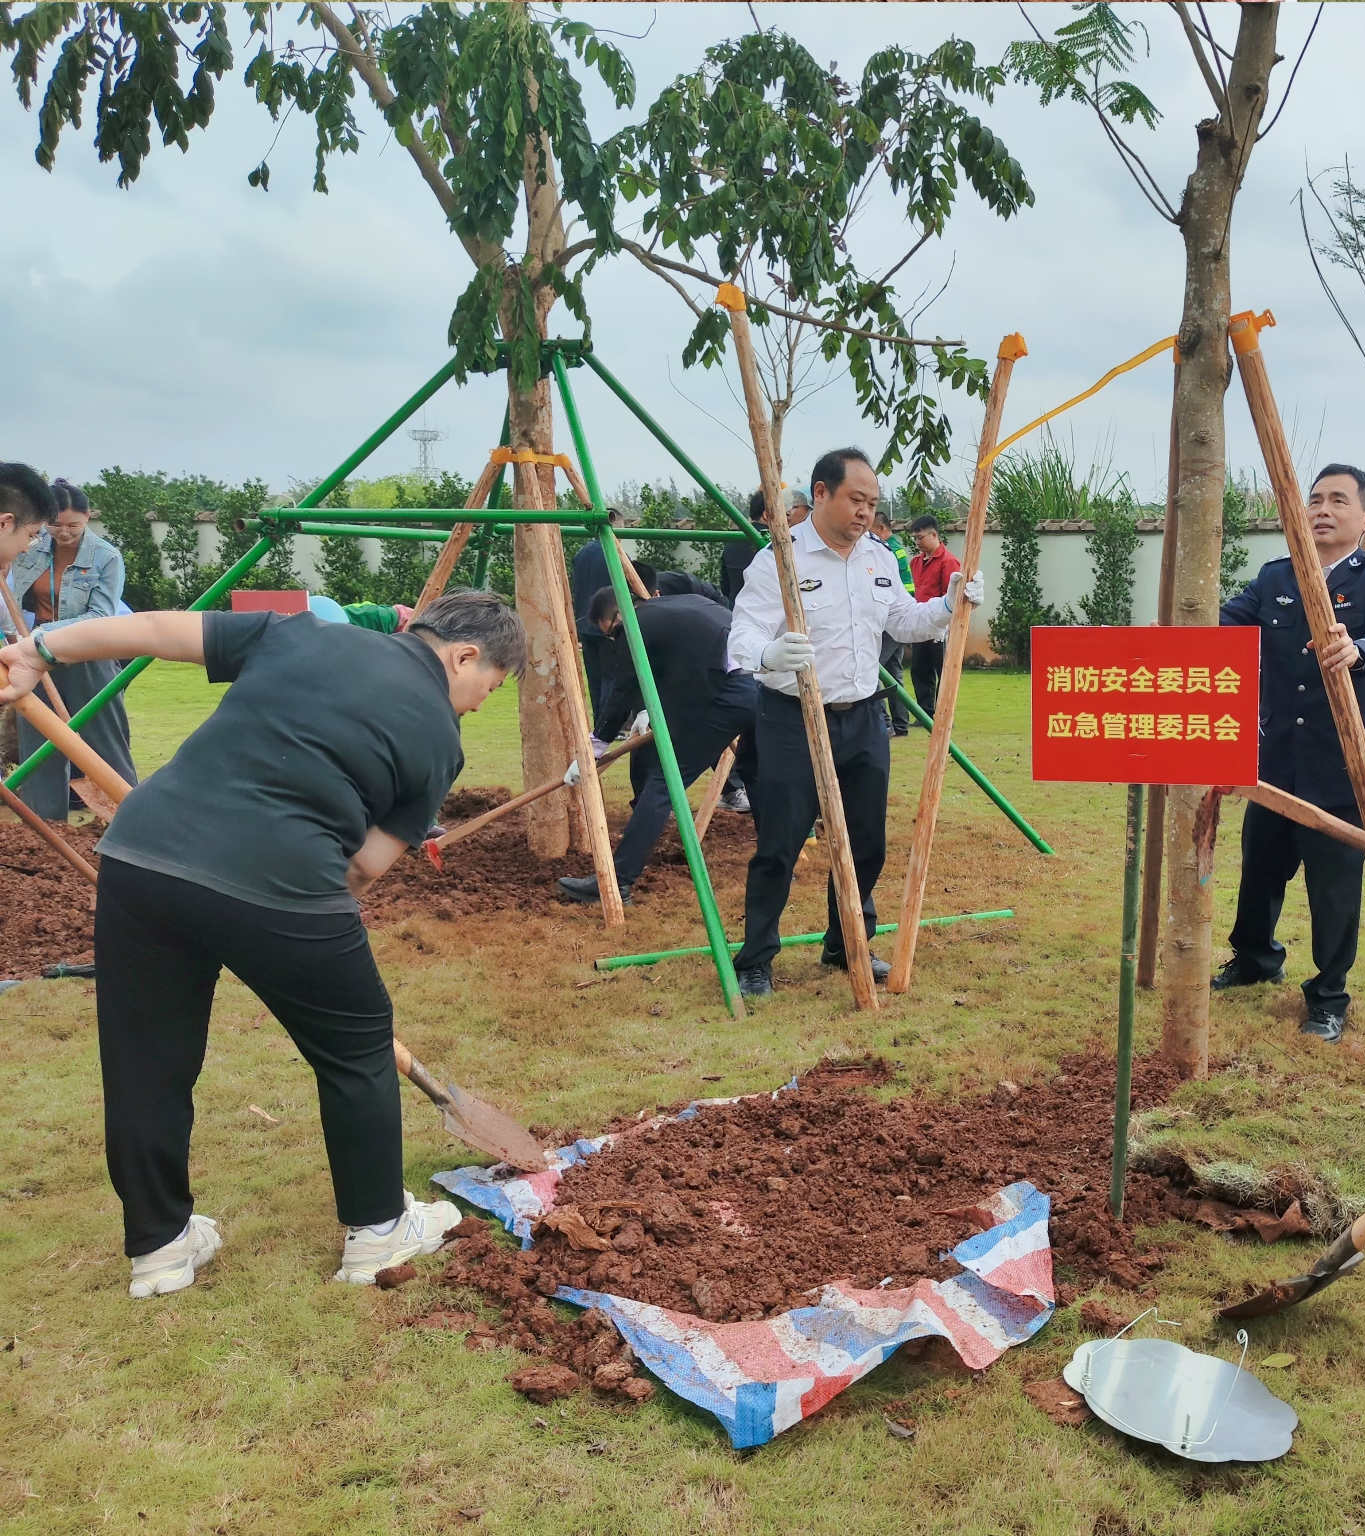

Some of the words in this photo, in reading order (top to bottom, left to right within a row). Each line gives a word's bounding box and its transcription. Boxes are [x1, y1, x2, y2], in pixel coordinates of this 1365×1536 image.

[1046, 666, 1241, 694] 消防安全委员会
[1046, 712, 1241, 741] 应急管理委员会
